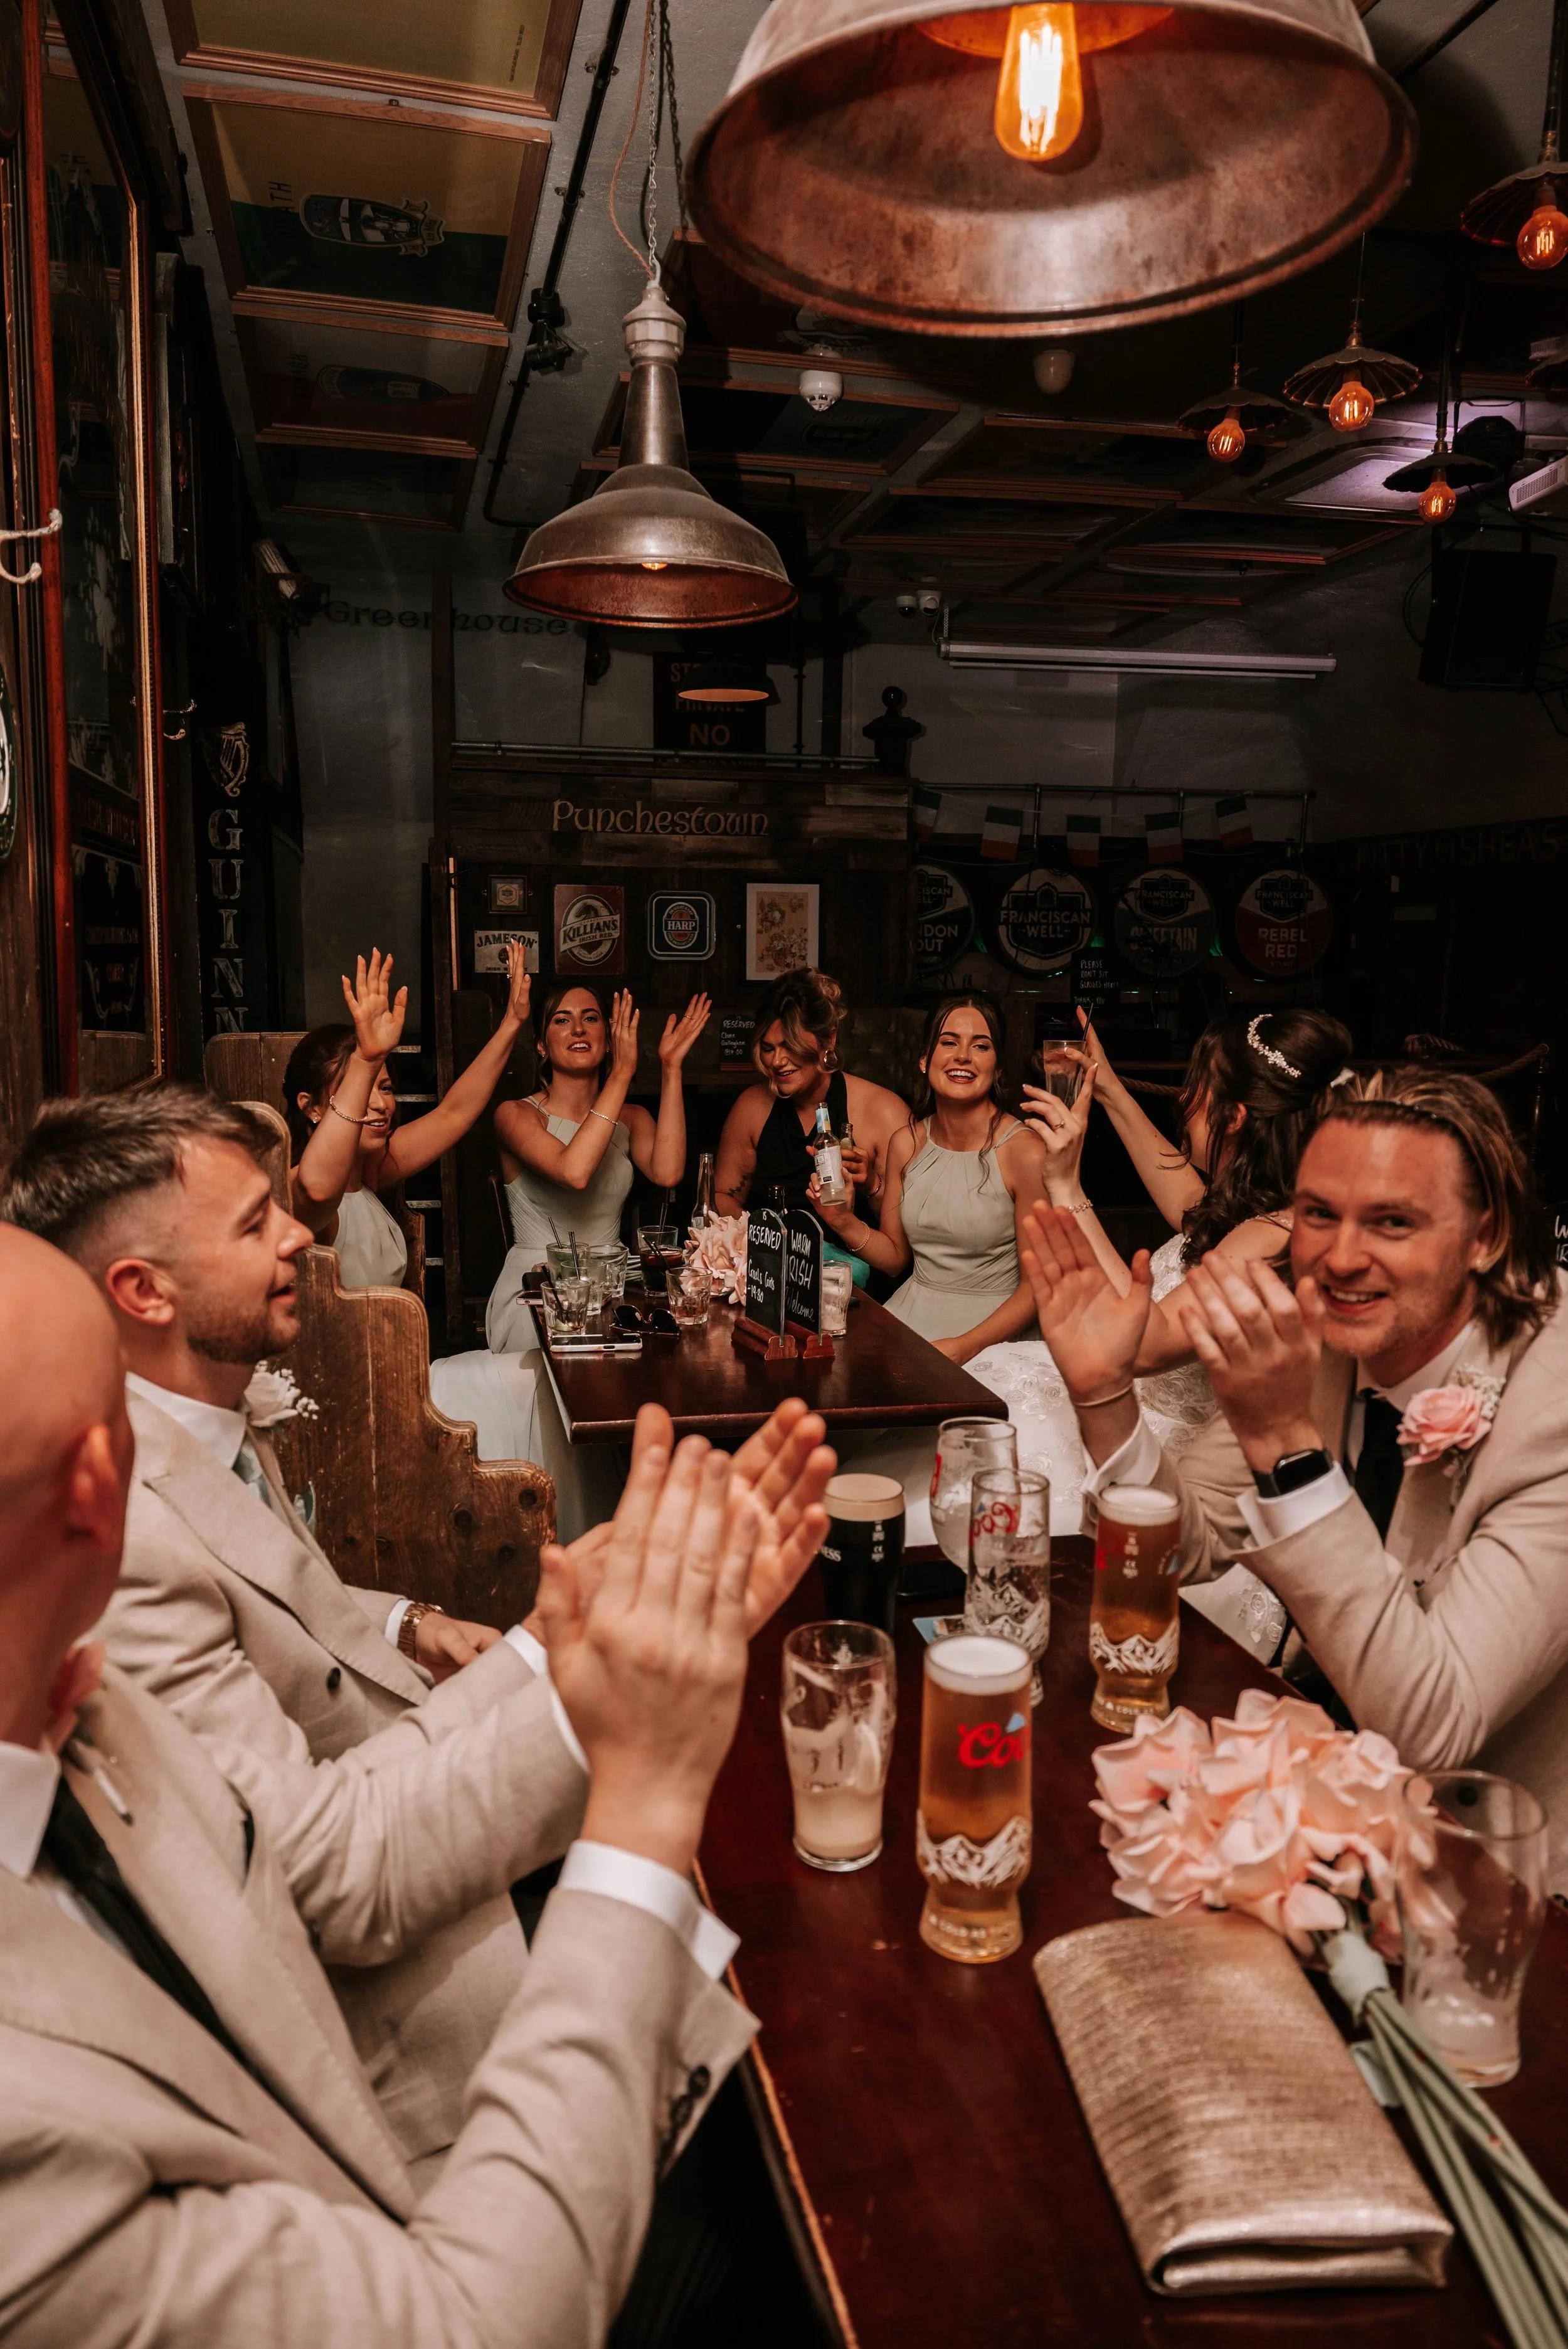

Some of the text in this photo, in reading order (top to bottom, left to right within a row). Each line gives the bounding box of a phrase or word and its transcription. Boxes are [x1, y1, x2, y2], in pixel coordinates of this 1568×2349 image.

[690, 723, 731, 746] NO
[552, 799, 770, 836] Punchestown
[1136, 889, 1192, 899] FRANCISCAN
[1257, 890, 1311, 899] FRANCISCAN
[1152, 899, 1175, 908] WELL
[1272, 899, 1295, 908] WELL
[1000, 910, 1091, 924] FRANCISCAN
[667, 920, 696, 931] HARP
[1027, 925, 1064, 938] WELL
[477, 933, 535, 949] JAMESON
[579, 933, 597, 943] IRISH
[1258, 927, 1308, 942] REBEL
[1265, 943, 1297, 958] RED
[1080, 959, 1103, 969] PLEASE
[723, 1019, 756, 1029] RESERVED
[748, 1224, 781, 1251] RESERVED
[791, 1229, 812, 1258] WARM
[785, 1254, 813, 1290] IRISH
